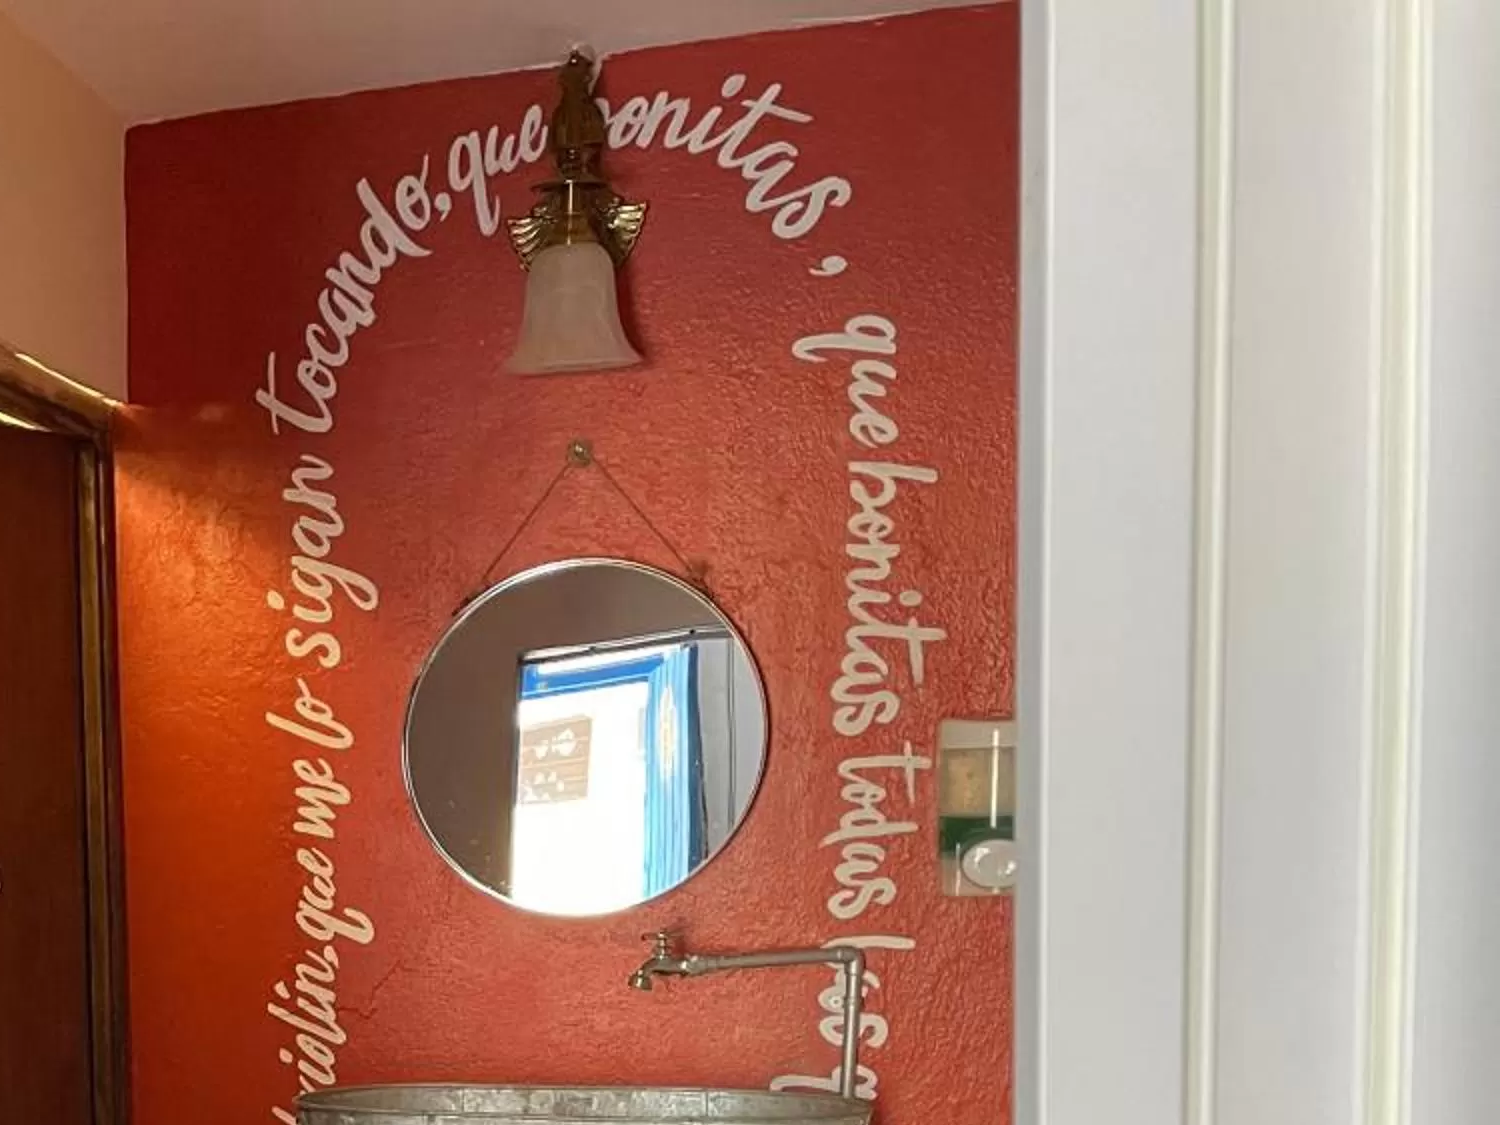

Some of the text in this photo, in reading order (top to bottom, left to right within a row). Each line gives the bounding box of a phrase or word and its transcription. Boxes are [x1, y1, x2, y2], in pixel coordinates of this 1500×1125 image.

[448, 104, 548, 237] que
[791, 314, 899, 448] que
[266, 454, 379, 668] sigan
[830, 461, 947, 736] bonitas
[265, 677, 354, 749] lo
[292, 757, 351, 839] me
[818, 740, 932, 920] todas
[295, 848, 375, 944] que
